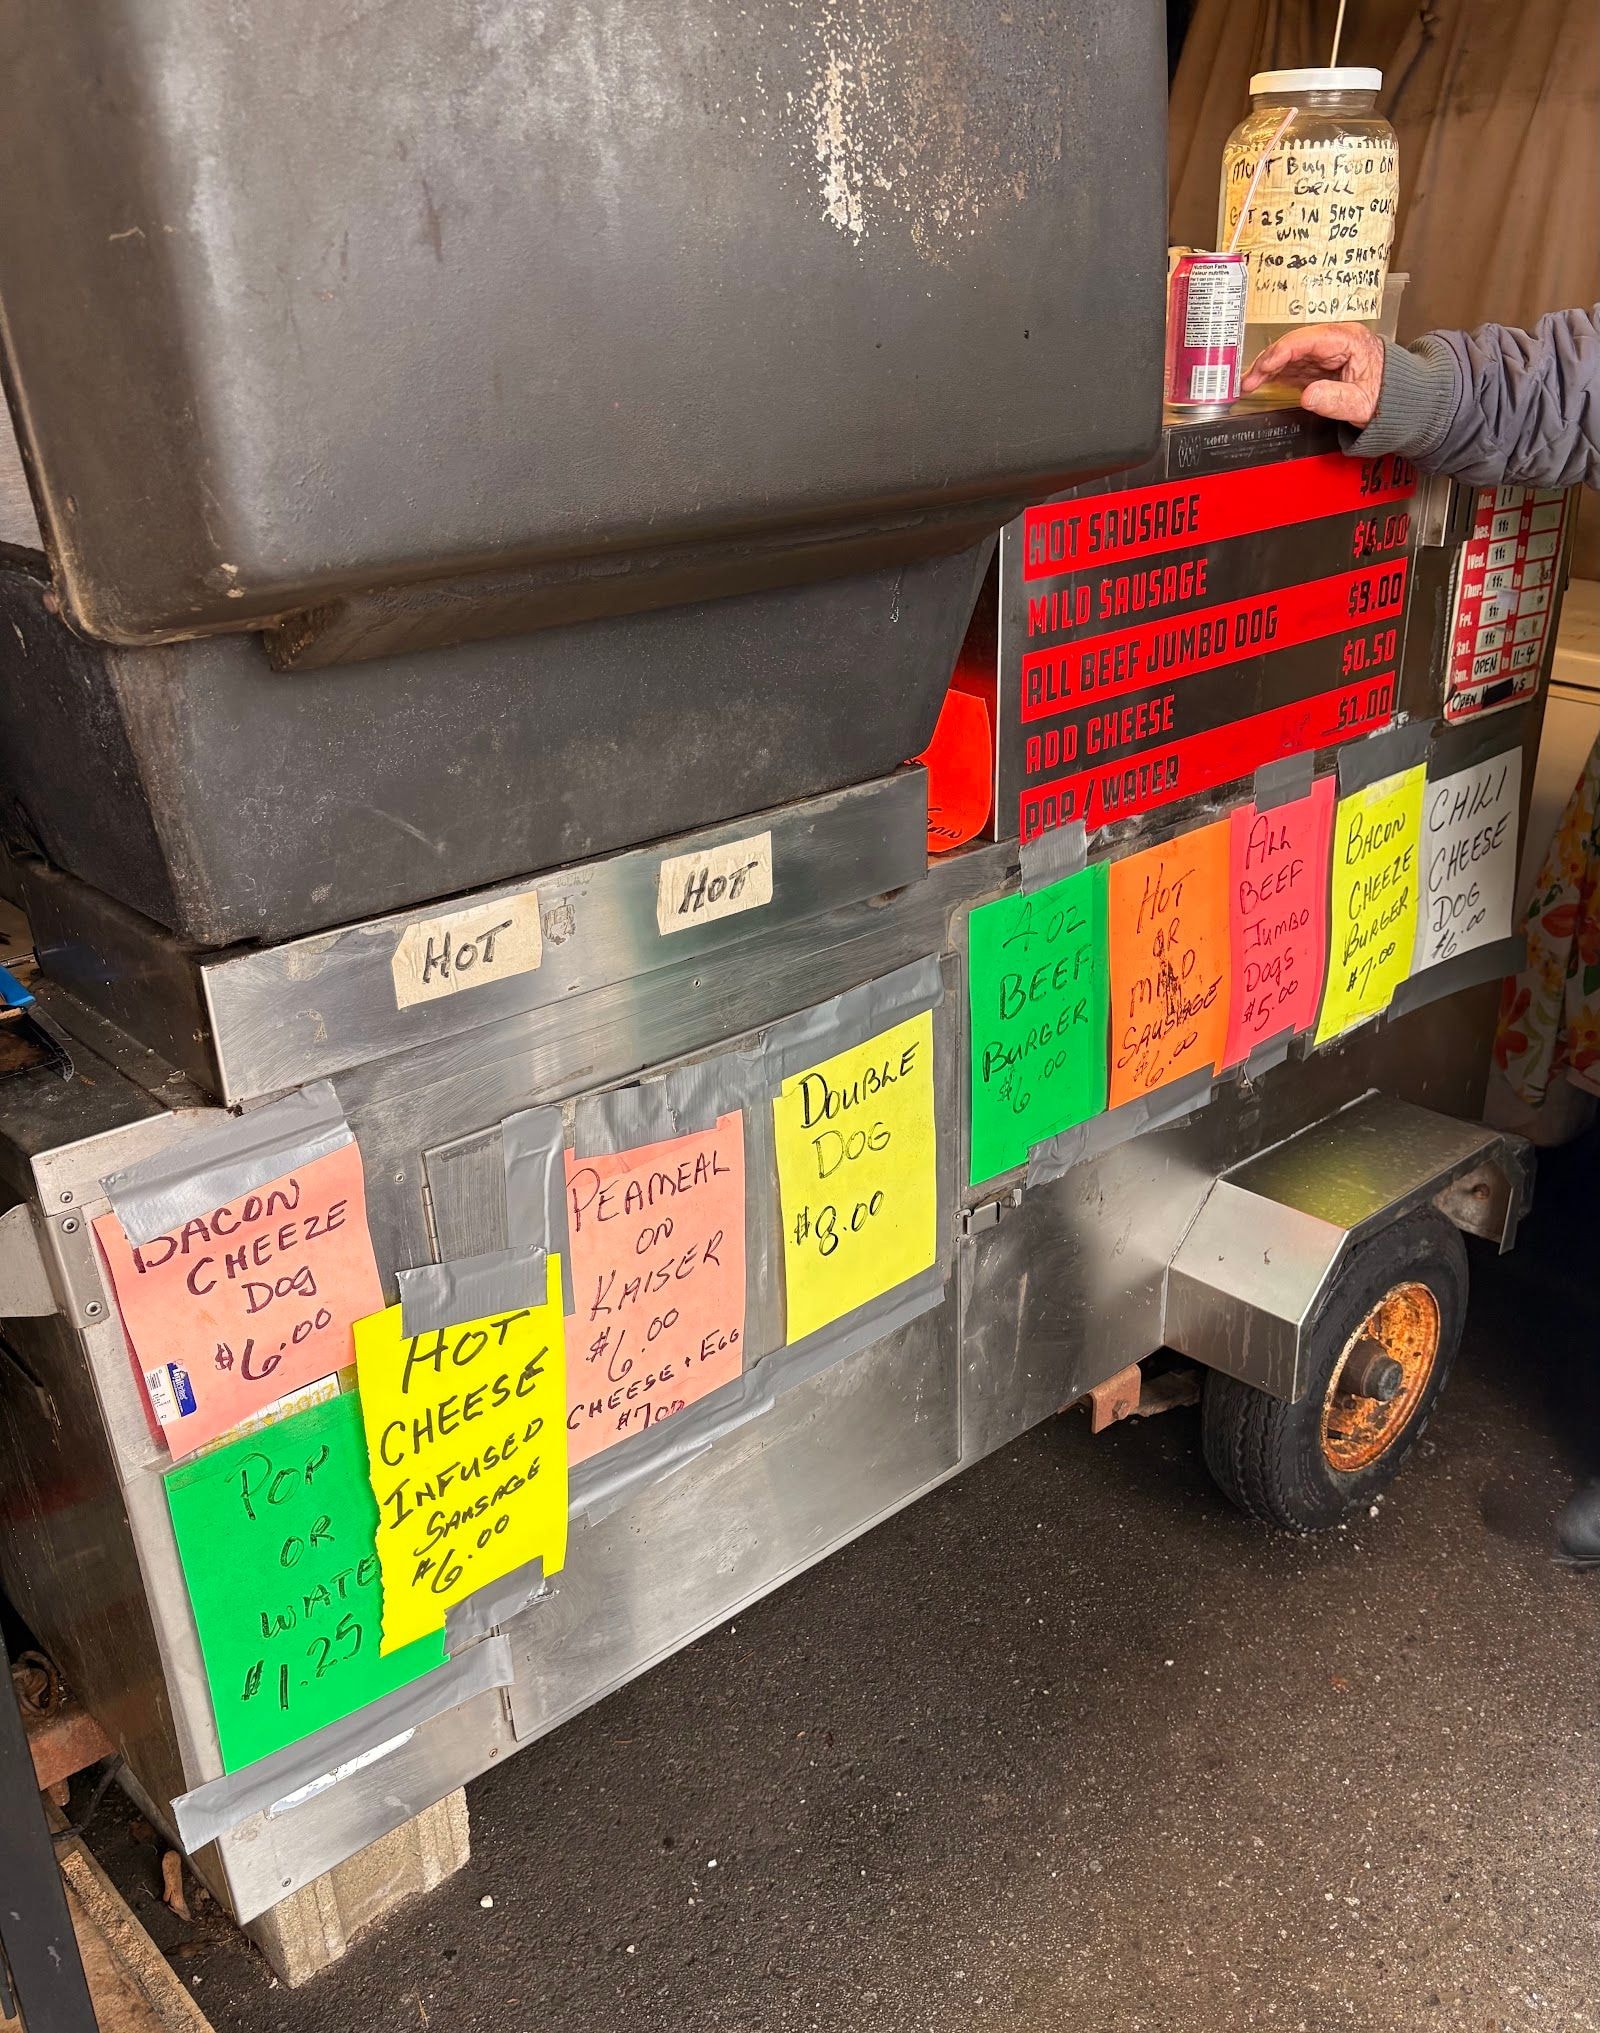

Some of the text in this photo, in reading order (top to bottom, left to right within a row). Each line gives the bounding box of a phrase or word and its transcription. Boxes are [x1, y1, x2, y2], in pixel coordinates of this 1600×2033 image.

[1233, 156, 1282, 182] MUT
[1294, 177, 1354, 195] GRILL
[1230, 206, 1257, 226] GT
[1302, 207, 1319, 223] IN
[1330, 204, 1365, 223] SHOT
[1277, 223, 1358, 242] WIN DOG
[1029, 517, 1081, 565] HOT
[1088, 494, 1201, 553] SAUSAGE
[1467, 552, 1485, 571] Wed.
[1029, 584, 1091, 637] MILD
[1100, 557, 1208, 620] SAUSAGE
[1459, 612, 1473, 628] Fri.
[1463, 584, 1482, 600] Thur.
[1027, 659, 1072, 708] ALL
[1081, 640, 1140, 690] BEEF
[1147, 617, 1228, 675] JUMBO
[1234, 604, 1279, 648] DOG
[1456, 640, 1471, 657] Sat.
[1474, 653, 1498, 675] OPEN
[1026, 628, 1396, 775] ADD CHEESE $0.50
[1101, 753, 1179, 811] WATER
[1337, 687, 1389, 729] $1.00
[1429, 766, 1508, 833] CHILI
[1346, 811, 1406, 865] BACON
[1428, 811, 1512, 893] CHEESE
[678, 861, 759, 915] HOT
[1136, 862, 1196, 935] HOT
[1239, 859, 1304, 915] BEEF
[1349, 843, 1414, 921] CHEEZE
[1432, 882, 1480, 932] DOG
[422, 919, 513, 984] HOT
[1153, 917, 1179, 958] OR
[1342, 886, 1409, 967] BURGER
[1432, 907, 1486, 960] $6.00
[1000, 943, 1094, 1020] BEEF
[1241, 979, 1299, 1032] $5.00
[1346, 941, 1396, 1001] $7.00
[982, 999, 1088, 1083] BURGER
[800, 1041, 920, 1129] DOUBLE
[813, 1121, 891, 1180] DOG
[566, 1150, 731, 1232] PEAMEAL
[792, 1190, 885, 1256] $8.00
[186, 1199, 348, 1296] CHEEZE
[589, 1230, 724, 1321] KAISER
[214, 1307, 332, 1381] $6.00
[401, 1309, 531, 1394] HOT
[586, 1308, 679, 1383] $6.00
[380, 1346, 549, 1467] CHEESE
[566, 1364, 675, 1430] CHEESE
[224, 1444, 330, 1521] POP
[383, 1417, 544, 1529] INFUSED
[413, 1456, 541, 1556] SAUSAGE
[280, 1515, 335, 1568] OR
[412, 1514, 510, 1594] $6.00
[260, 1553, 379, 1639] WATE
[241, 1613, 364, 1710] $1.25
